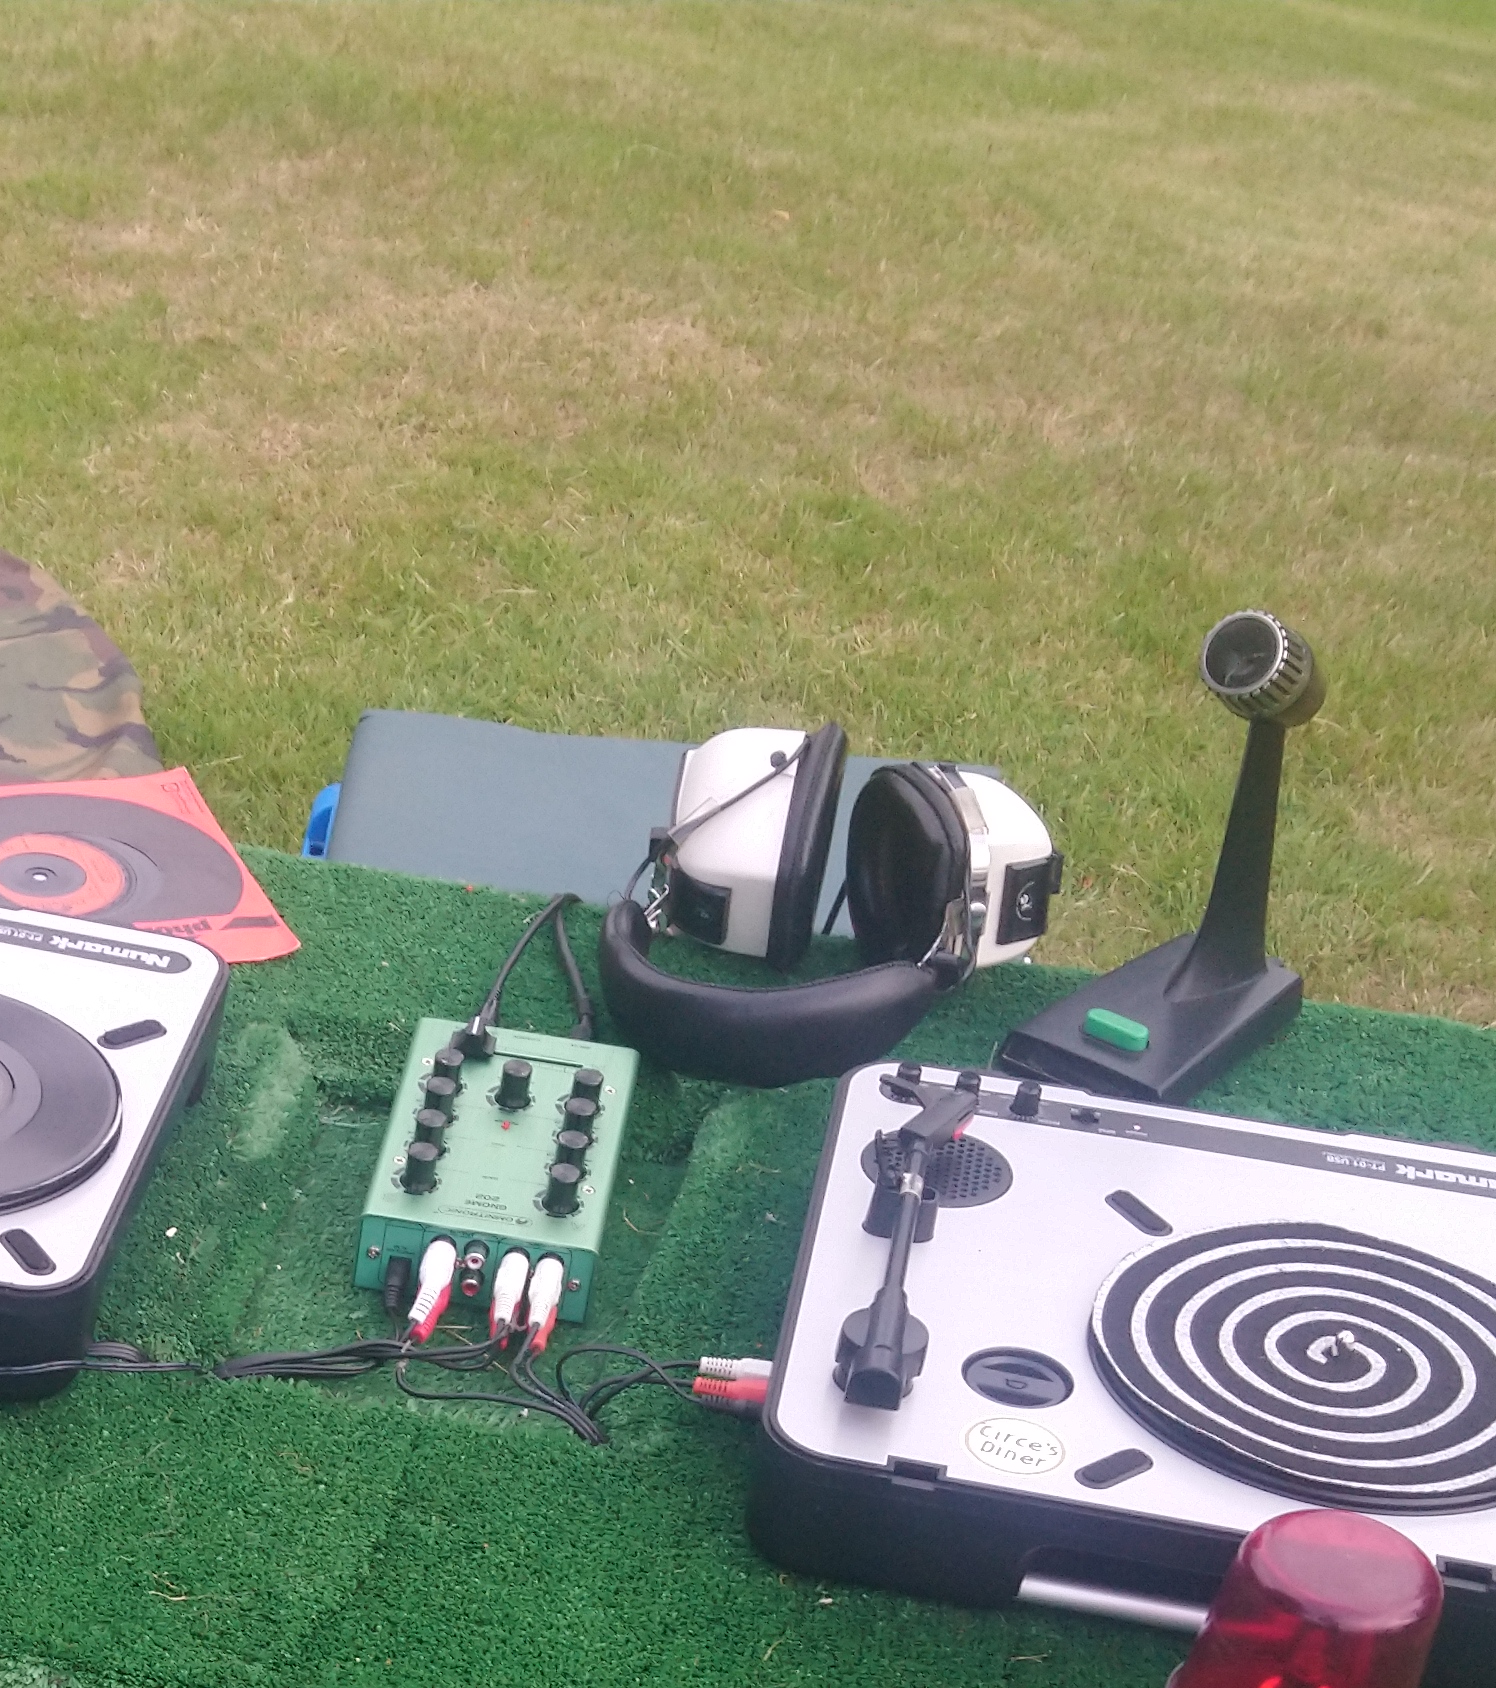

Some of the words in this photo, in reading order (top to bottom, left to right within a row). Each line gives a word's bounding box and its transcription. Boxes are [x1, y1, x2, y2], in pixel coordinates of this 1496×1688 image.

[49, 934, 171, 969] Numark
[1326, 1155, 1350, 1165] USB
[1352, 1158, 1387, 1171] PT-01
[979, 1425, 1059, 1456] Circe's
[980, 1440, 1047, 1467] Diner
